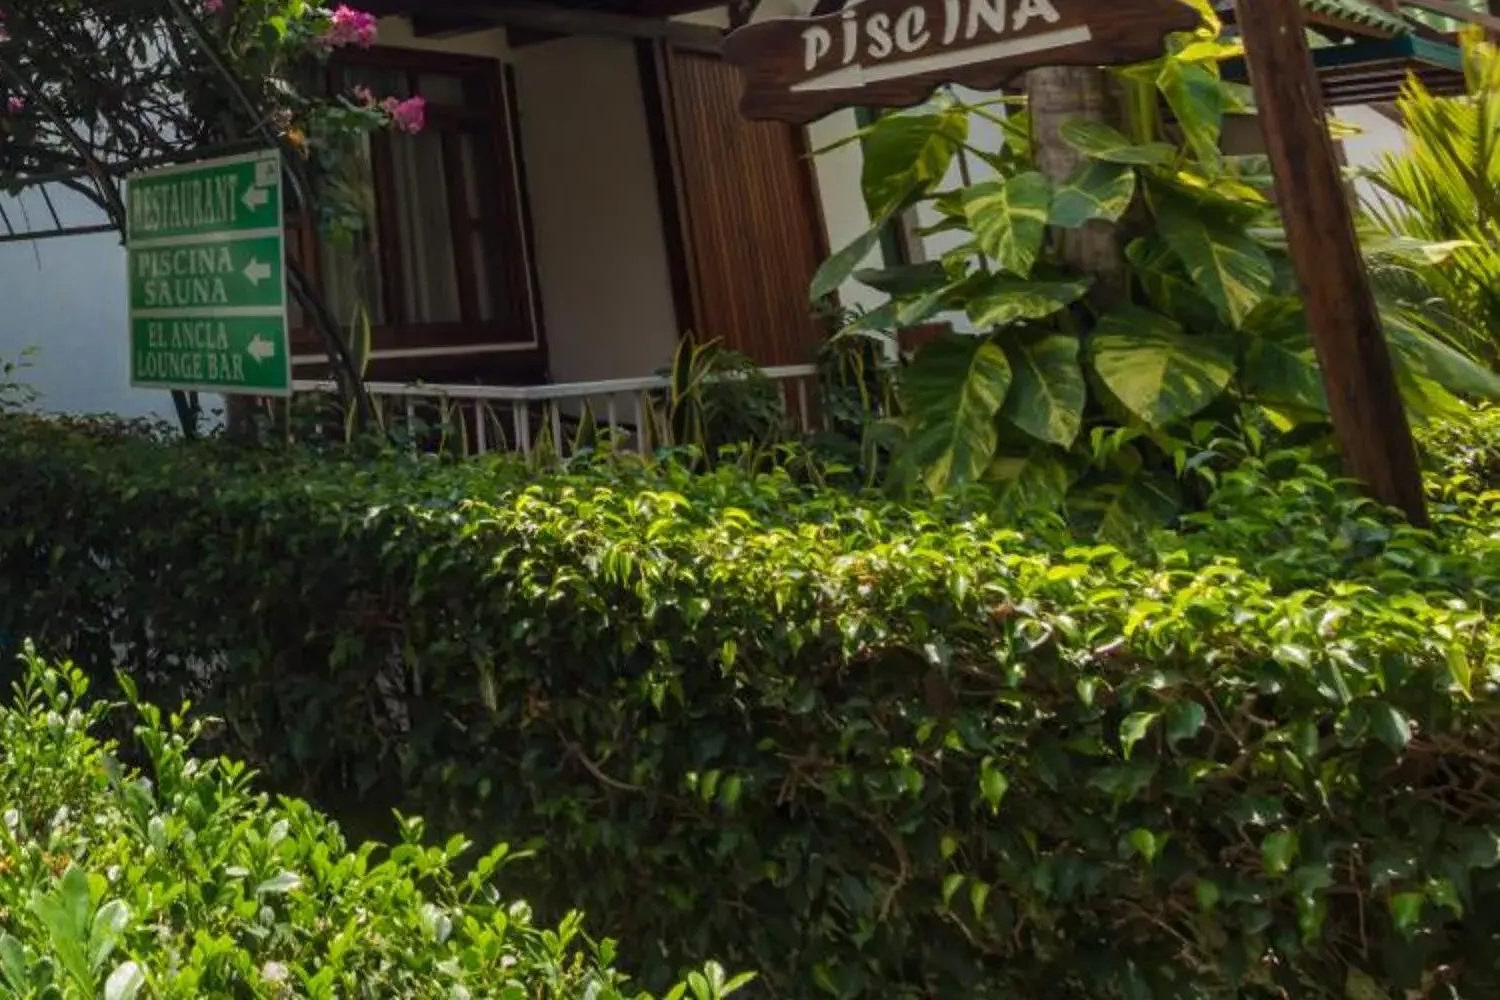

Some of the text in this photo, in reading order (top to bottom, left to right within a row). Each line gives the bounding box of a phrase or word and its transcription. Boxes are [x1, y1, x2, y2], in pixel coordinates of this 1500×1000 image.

[132, 174, 238, 231] RESTAURANT
[138, 247, 234, 278] PISCINA
[144, 277, 228, 306] SAUNA
[149, 321, 229, 350] EL ANCLA
[137, 352, 246, 381] LOUNGE BAR
